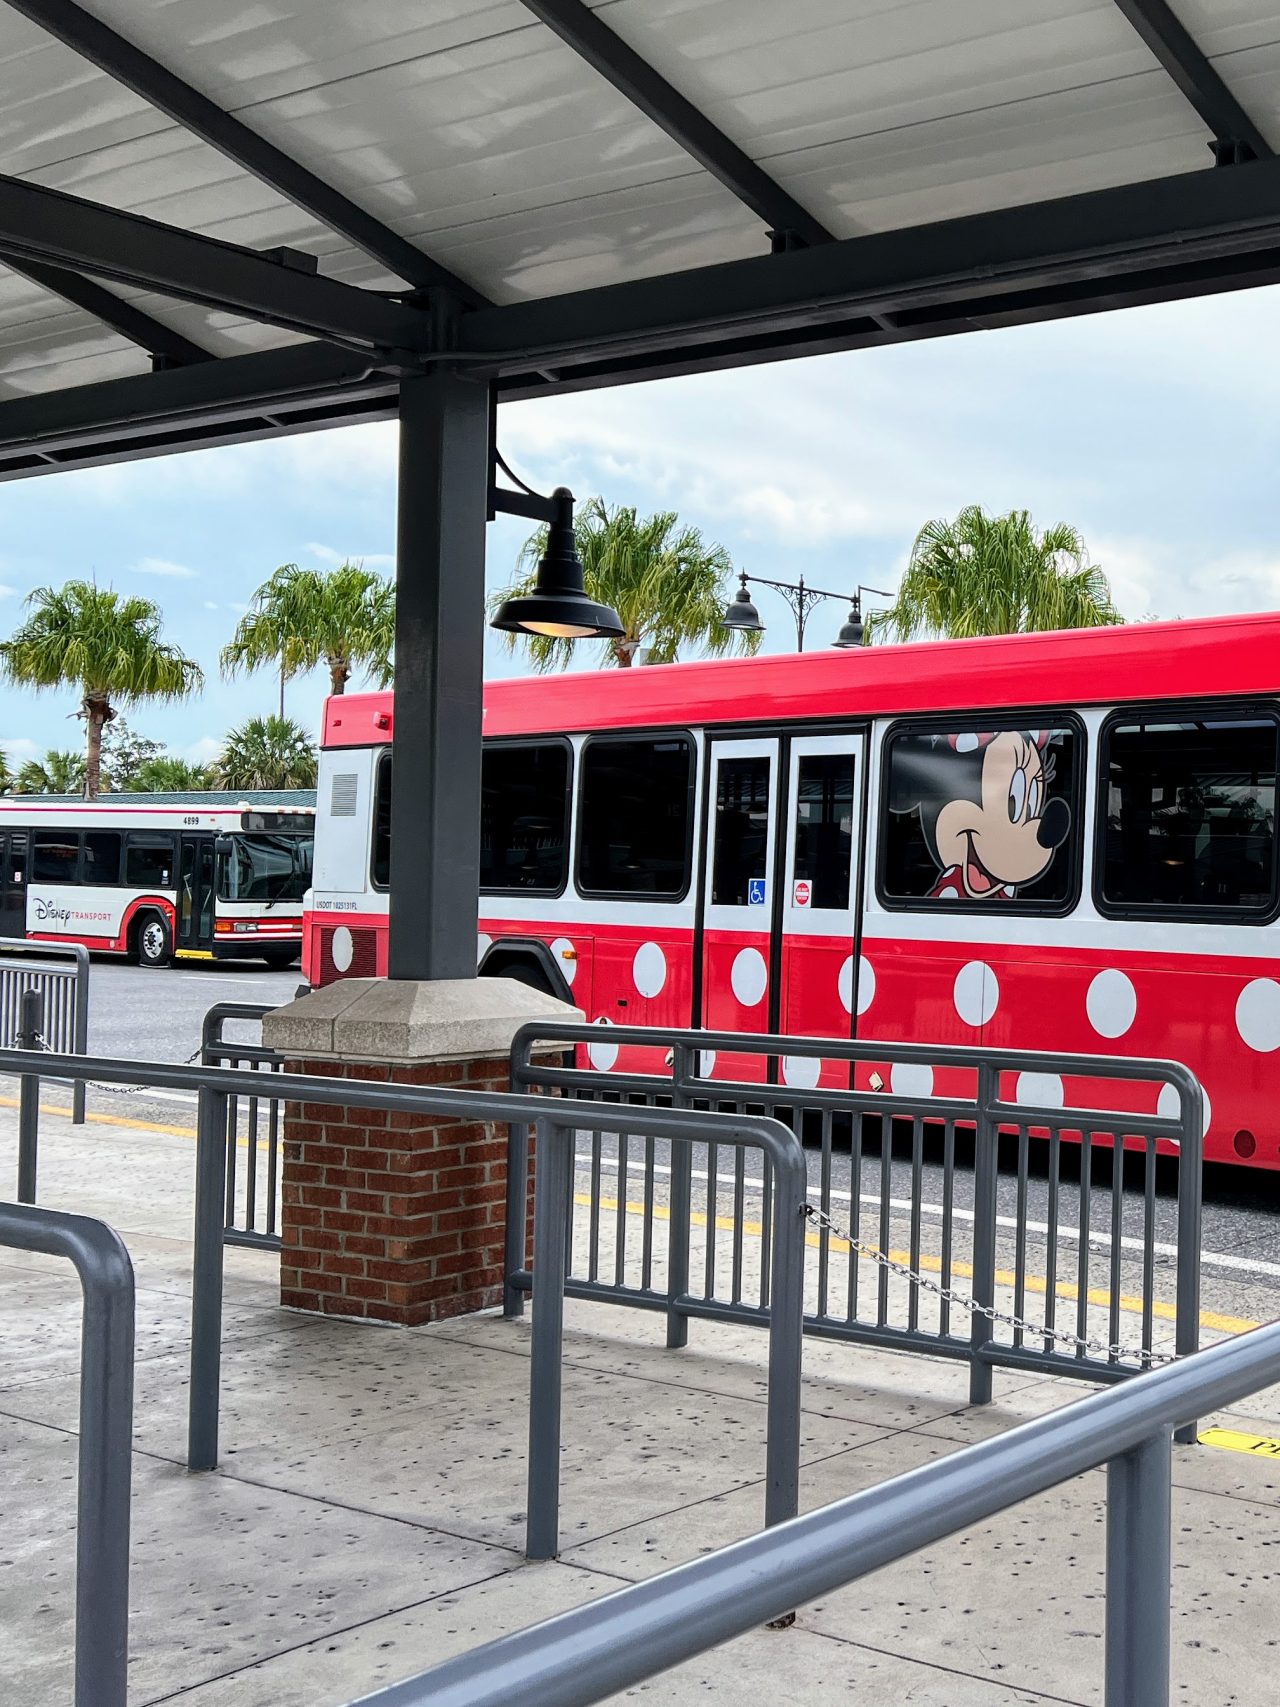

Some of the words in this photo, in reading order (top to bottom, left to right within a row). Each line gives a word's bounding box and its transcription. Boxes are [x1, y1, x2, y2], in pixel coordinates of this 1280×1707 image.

[184, 816, 199, 825] 4899
[316, 901, 332, 909] USDOT
[71, 911, 112, 921] TRANSPORT
